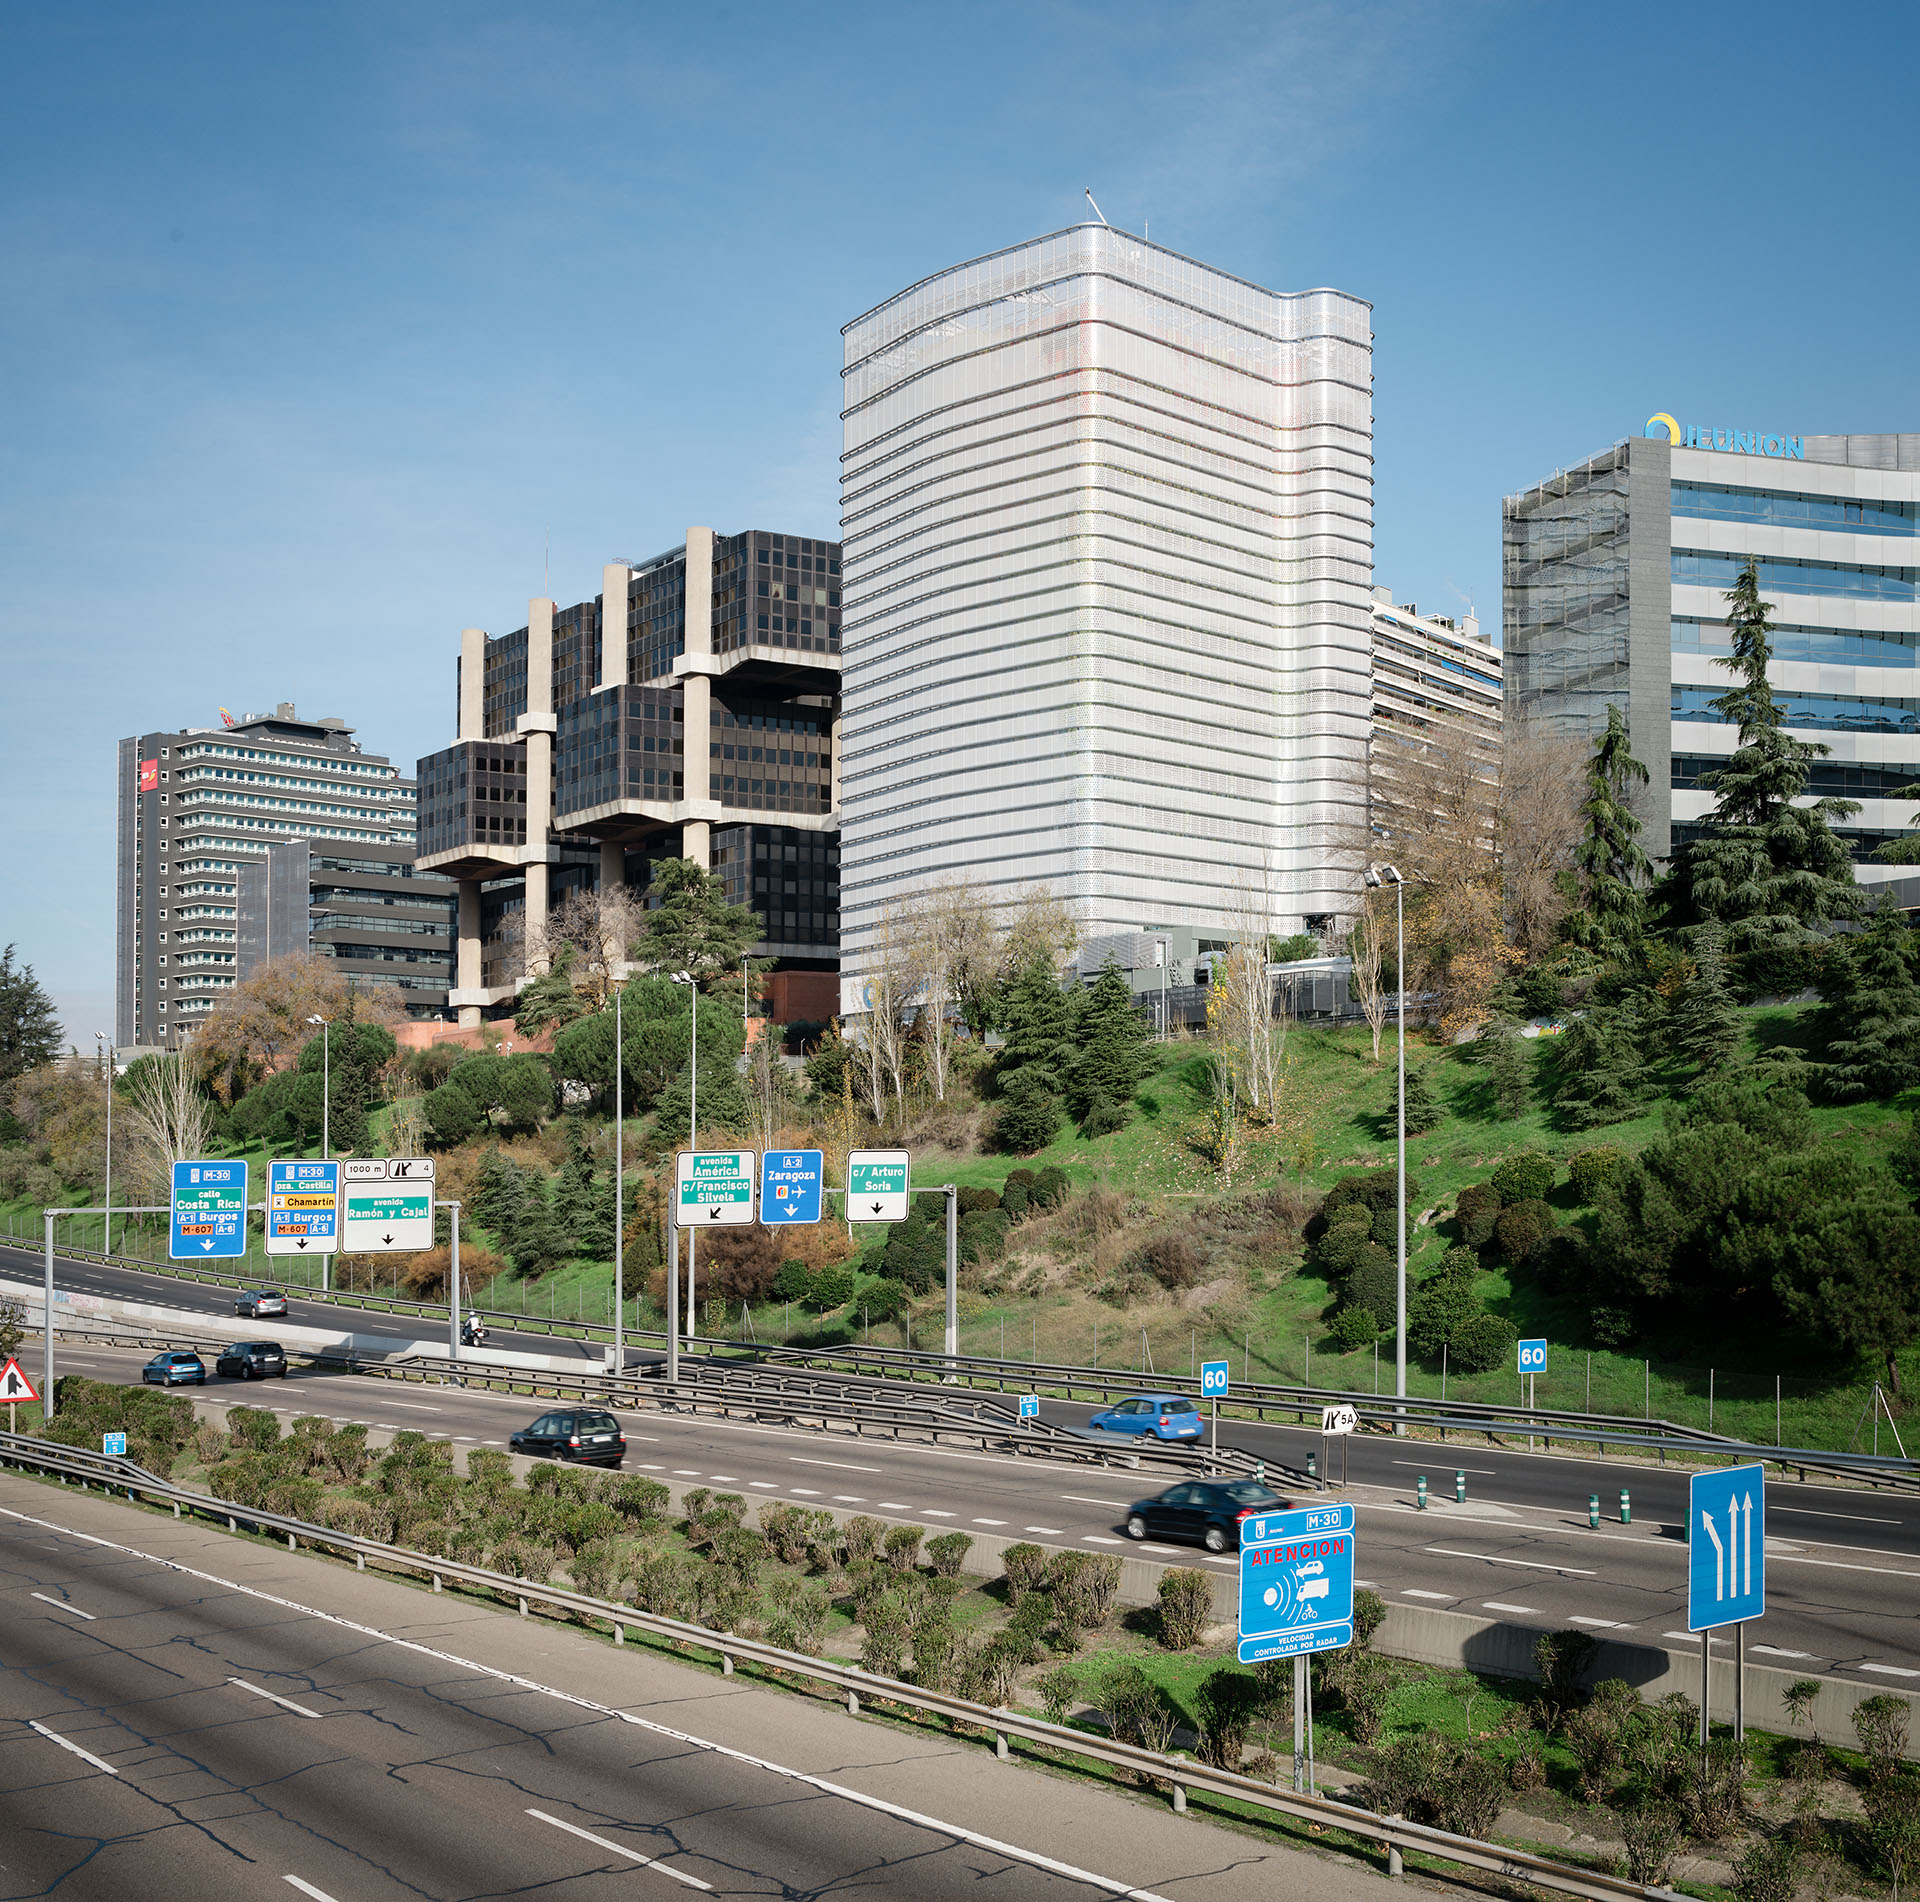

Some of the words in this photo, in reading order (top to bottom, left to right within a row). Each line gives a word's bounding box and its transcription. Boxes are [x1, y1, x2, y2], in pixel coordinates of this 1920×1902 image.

[1686, 424, 1805, 460] ILUNION
[700, 1157, 733, 1165] avenida
[785, 1158, 801, 1167] A-2
[300, 1168, 323, 1176] M-30
[349, 1165, 371, 1173] 1000
[694, 1166, 739, 1177] América
[852, 1167, 866, 1177] c/
[871, 1166, 904, 1177] Arturo
[205, 1171, 229, 1180] M-30
[768, 1170, 816, 1183] Zaragoza
[277, 1183, 294, 1191] pza.
[298, 1181, 332, 1190] Castilla
[865, 1181, 892, 1192] Soria
[198, 1190, 221, 1198] calle
[697, 1192, 735, 1202] Silvela
[176, 1200, 210, 1210] Costa
[217, 1199, 241, 1209] Rica
[287, 1197, 335, 1206] Chamartín
[373, 1198, 404, 1206] avenida
[179, 1214, 194, 1222] A-1
[199, 1212, 239, 1224] Burgos
[275, 1214, 289, 1222] A-1
[293, 1213, 333, 1224] Burgos
[348, 1208, 384, 1218] Ramón
[389, 1210, 396, 1219] y
[401, 1207, 428, 1218] Cajal
[182, 1225, 212, 1234] M-607
[217, 1225, 234, 1233] A-6
[278, 1225, 307, 1233] M-607
[312, 1225, 327, 1233] A-6
[1521, 1347, 1544, 1365] 60
[1205, 1370, 1226, 1389] 60
[1341, 1413, 1353, 1424] 5A
[1309, 1513, 1339, 1528] M-30
[1252, 1539, 1344, 1566] ATENCION
[1278, 1633, 1315, 1645] VELOCIDAD
[1254, 1644, 1298, 1657] CONTROLADA
[1300, 1641, 1314, 1650] POR
[1316, 1637, 1338, 1647] RADAR
